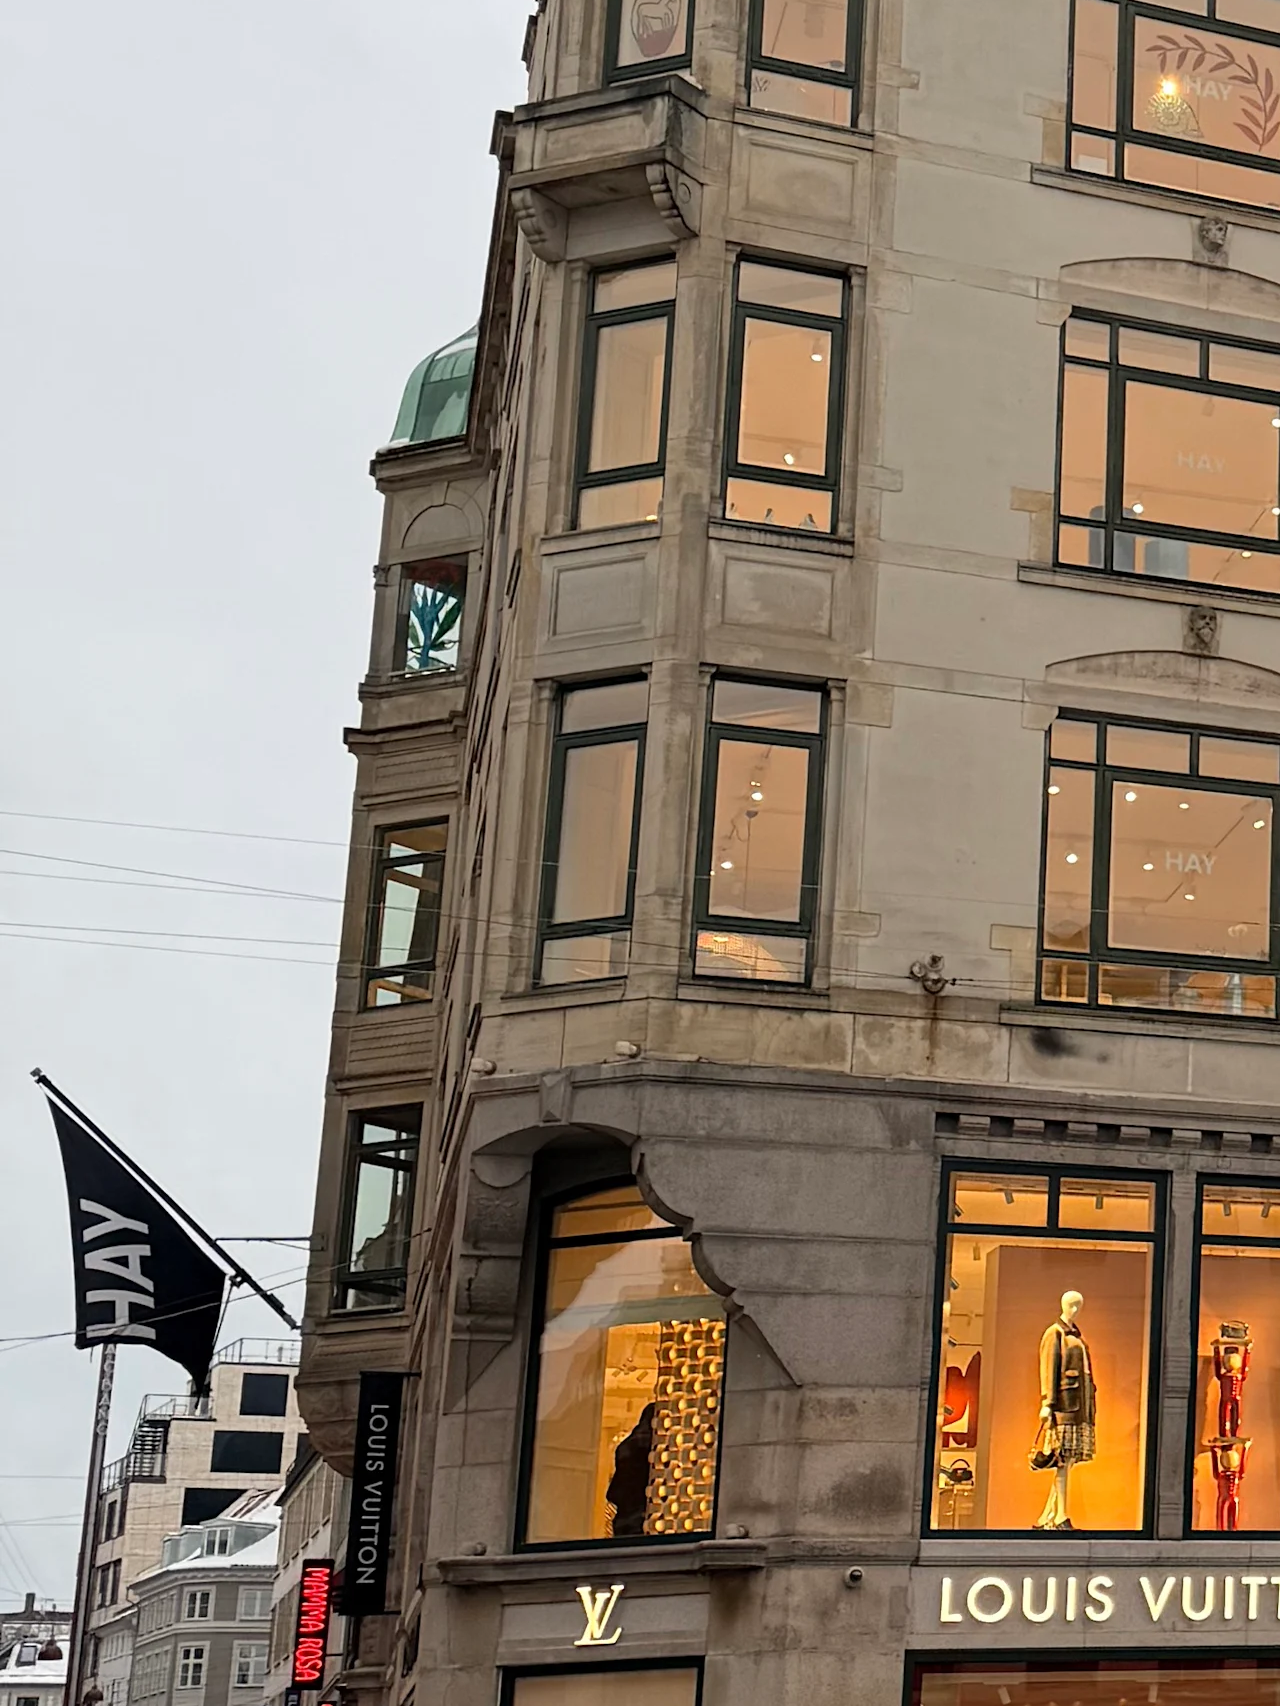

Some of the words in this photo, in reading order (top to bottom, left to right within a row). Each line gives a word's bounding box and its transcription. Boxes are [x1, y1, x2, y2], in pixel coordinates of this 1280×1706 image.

[1184, 74, 1233, 101] HAY
[1177, 450, 1226, 473] HAY
[1165, 850, 1217, 875] HAY
[79, 1198, 157, 1341] HAY
[366, 1404, 389, 1471] LOUIS
[356, 1481, 383, 1584] VUITTON
[299, 1567, 330, 1632] MAMMA
[940, 1576, 1115, 1624] LOUIS
[294, 1638, 323, 1681] ROSA
